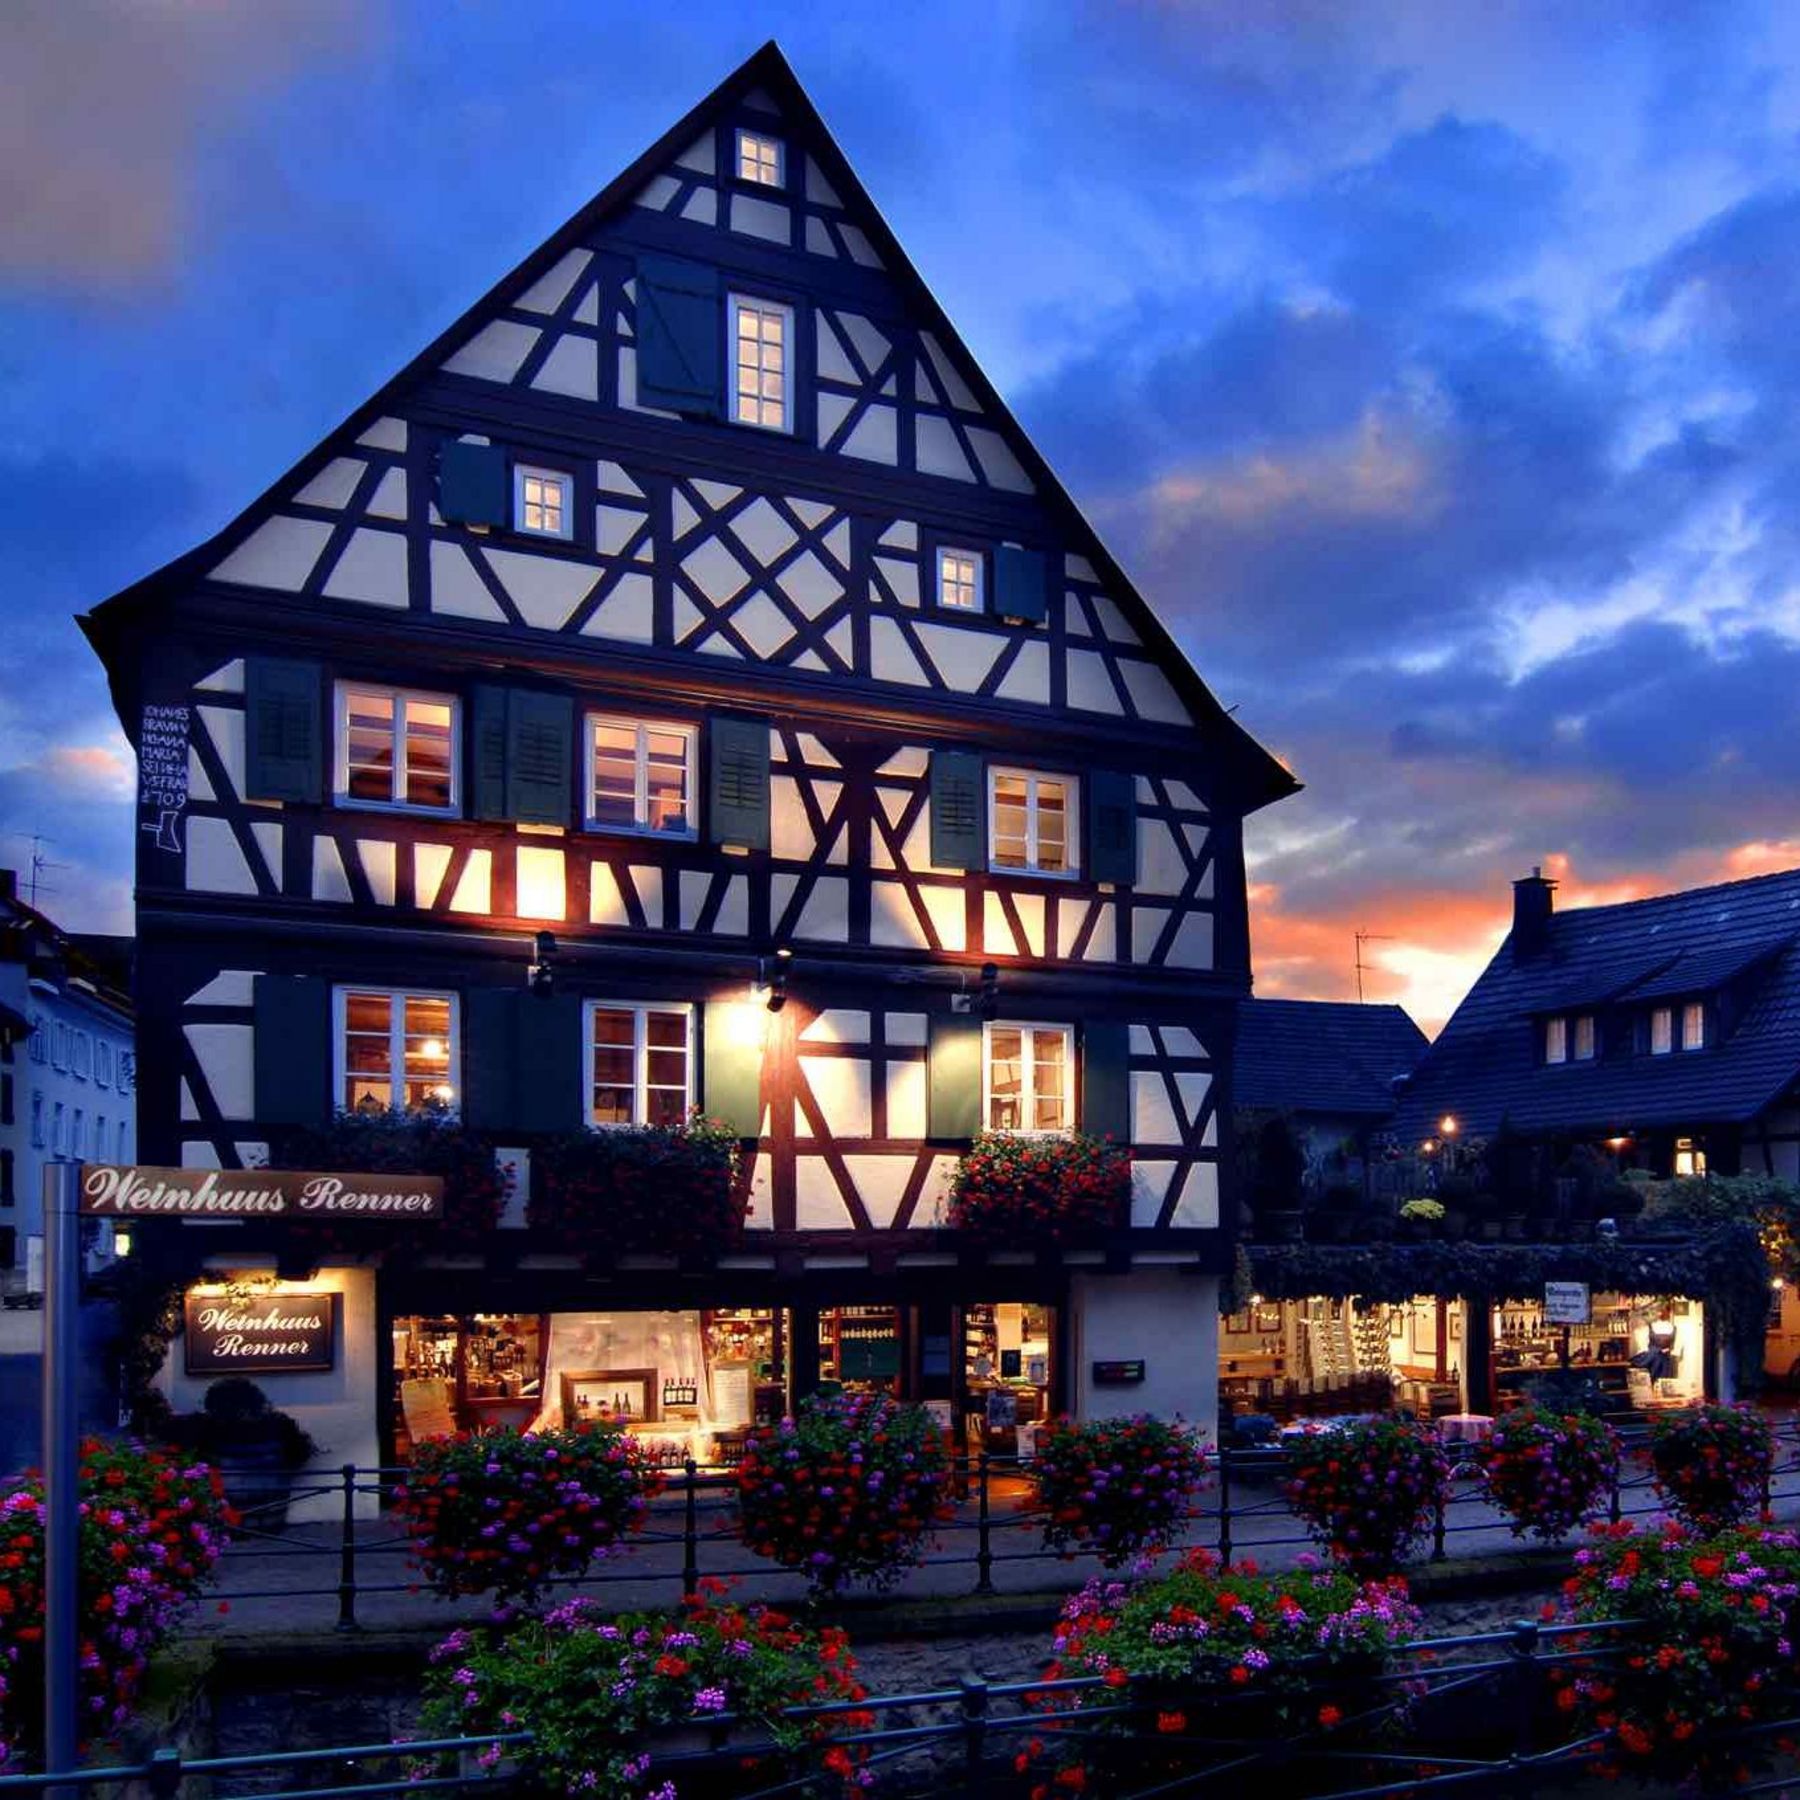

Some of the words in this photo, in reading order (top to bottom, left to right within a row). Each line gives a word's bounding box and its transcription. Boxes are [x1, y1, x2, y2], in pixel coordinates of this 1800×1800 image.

[84, 1167, 286, 1212] Weinhaus
[299, 1176, 434, 1213] Renner
[198, 1307, 322, 1332] Weinhaus
[212, 1333, 311, 1357] Renner
